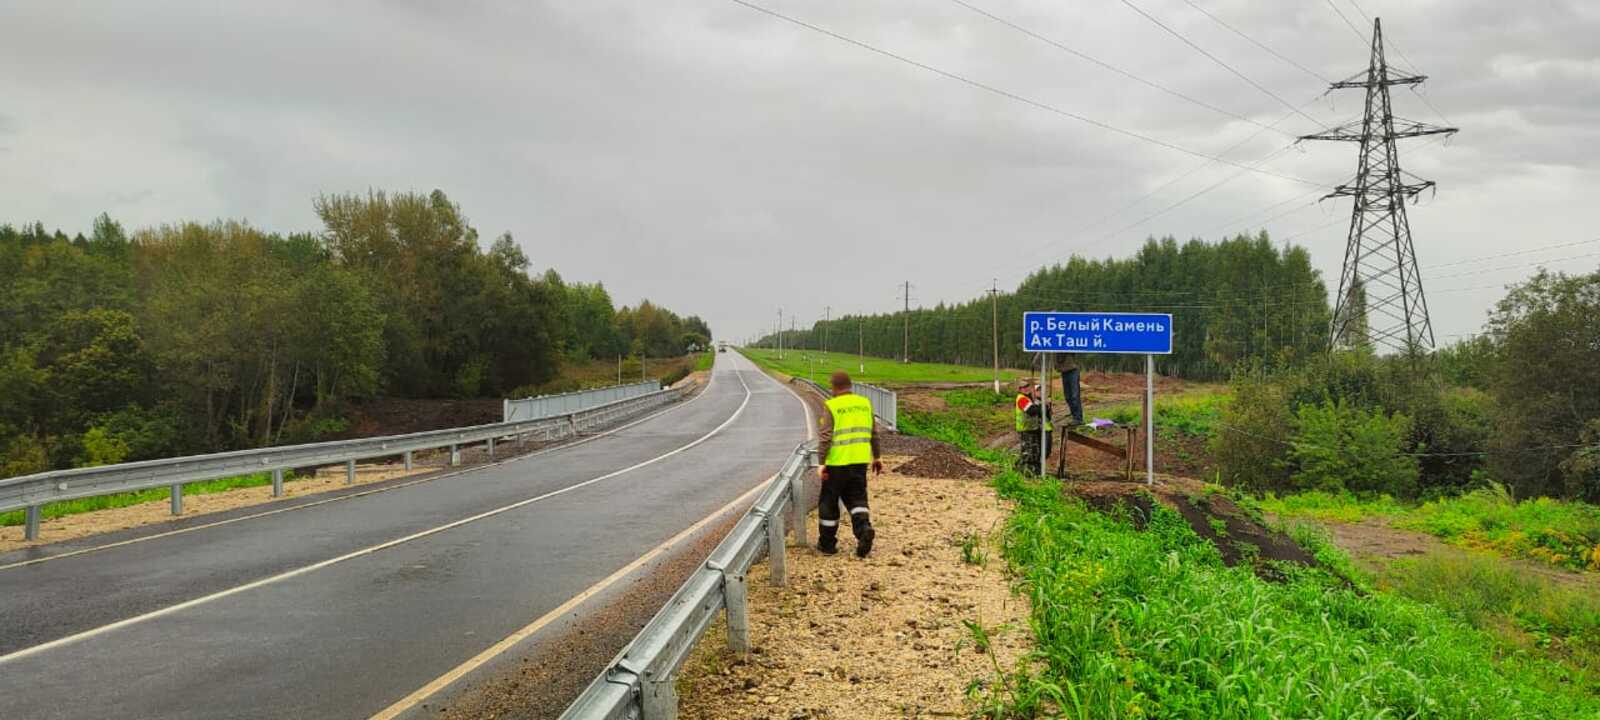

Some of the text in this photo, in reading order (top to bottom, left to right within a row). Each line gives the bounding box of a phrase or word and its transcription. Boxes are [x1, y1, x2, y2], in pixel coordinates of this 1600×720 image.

[1030, 316, 1165, 333] р. Белый Камень
[1056, 334, 1089, 348] Таш
[1093, 334, 1107, 348] й.
